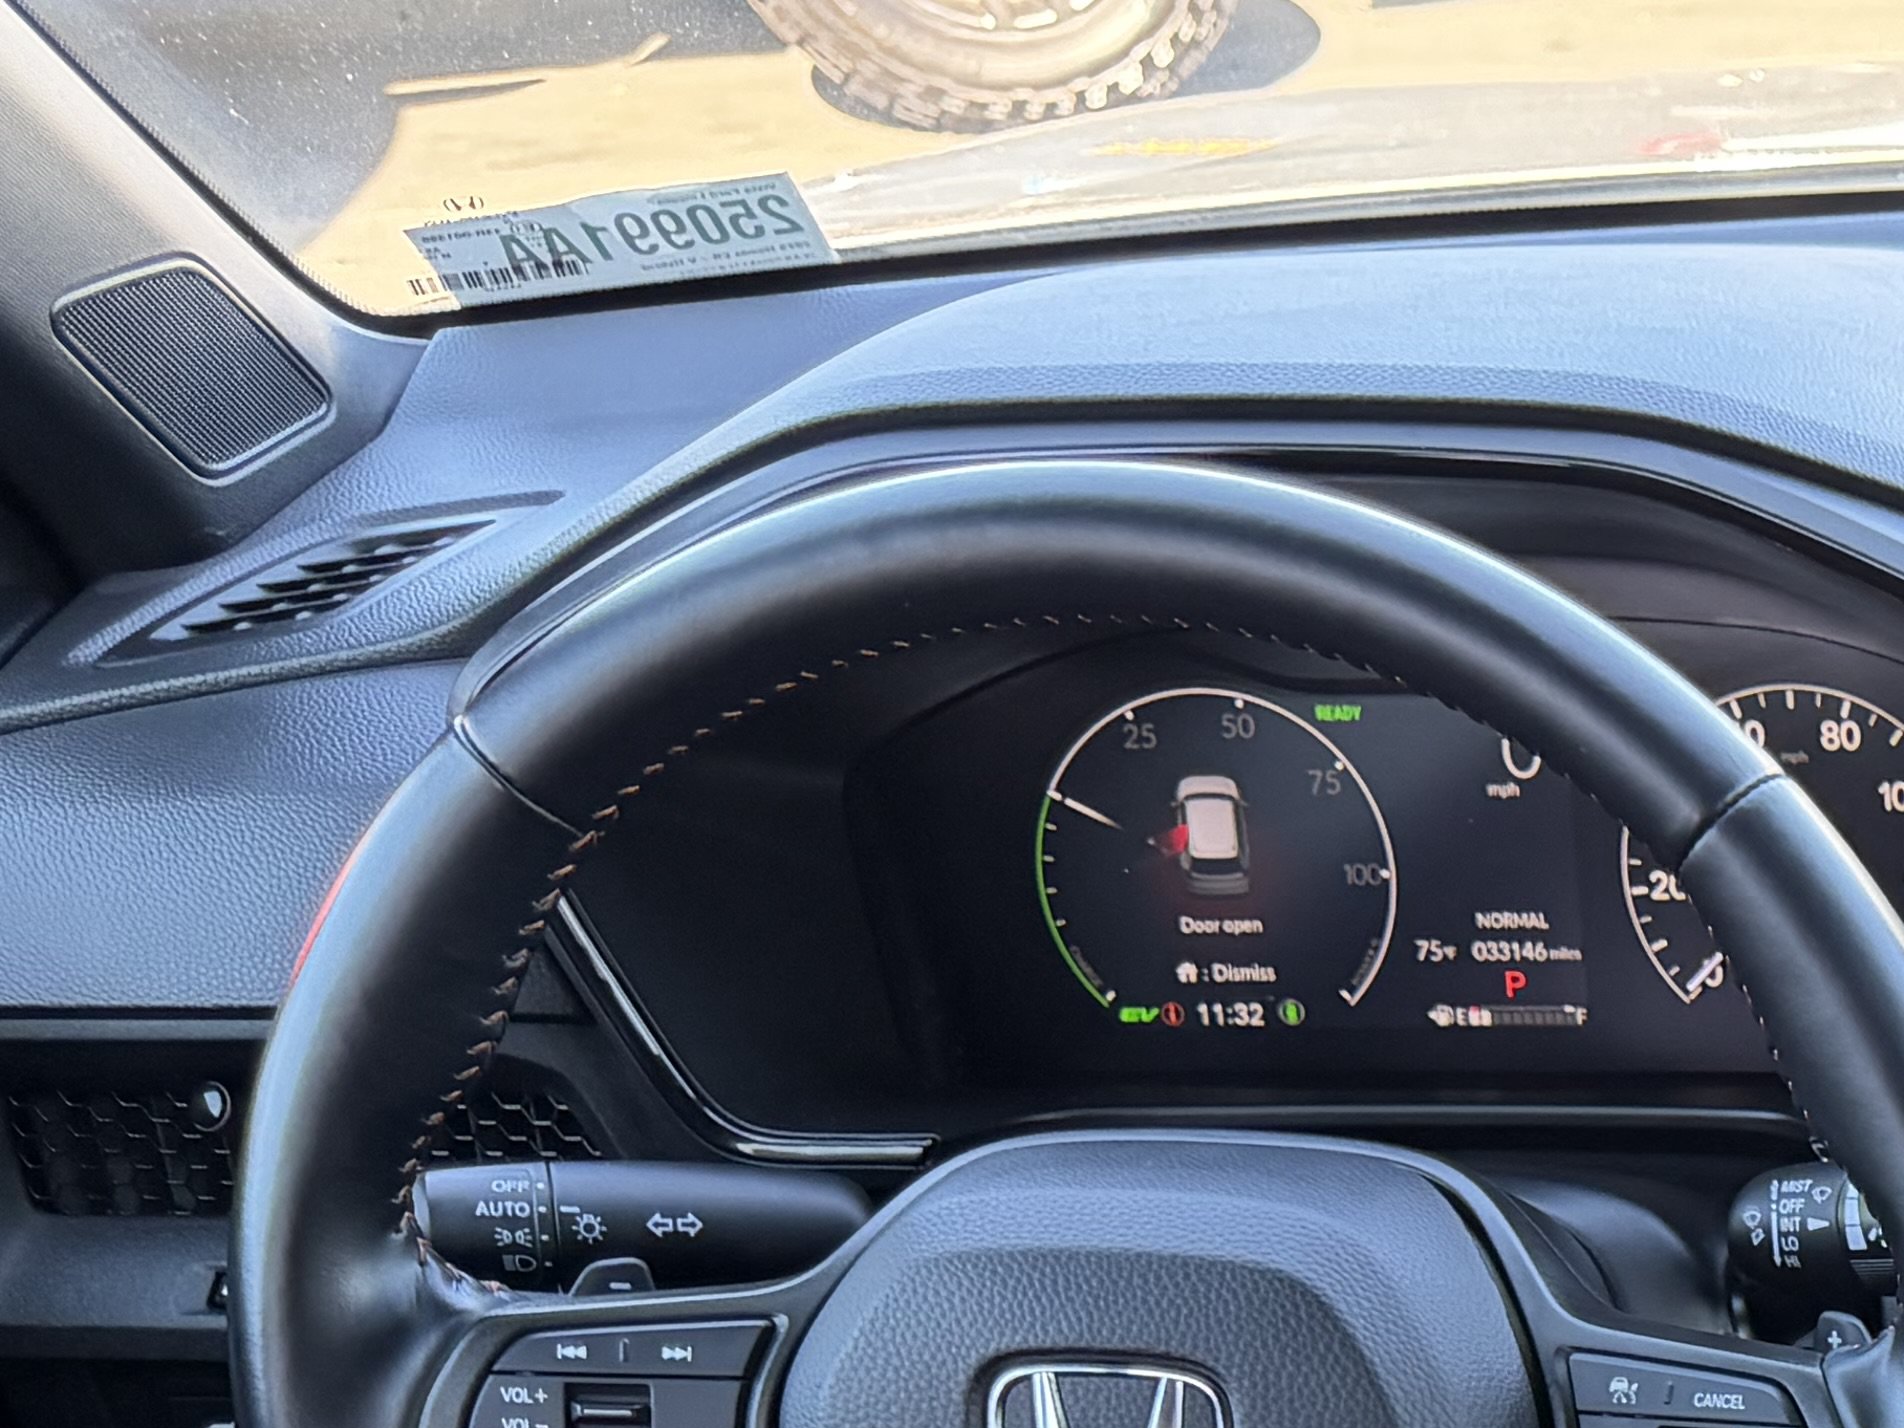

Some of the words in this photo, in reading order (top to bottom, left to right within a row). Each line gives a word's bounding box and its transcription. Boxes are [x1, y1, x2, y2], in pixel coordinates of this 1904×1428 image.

[1314, 703, 1362, 724] READY
[1122, 723, 1157, 750] 25
[1221, 713, 1256, 741] 50
[1819, 719, 1863, 752] 80
[1307, 769, 1342, 797] 75
[1485, 781, 1520, 800] mph
[1344, 863, 1382, 887] 100
[1179, 915, 1219, 934] Door
[1222, 918, 1264, 936] open
[1474, 911, 1549, 930] NORMAL
[1471, 940, 1548, 963] 033146
[1211, 963, 1277, 983] Dismiss
[1504, 969, 1527, 998] P
[1118, 1006, 1160, 1023] EV
[1197, 1001, 1265, 1027] 11:32
[1456, 1007, 1467, 1027] E
[1576, 1008, 1588, 1026] F
[490, 1178, 530, 1193] OFF
[1780, 1179, 1813, 1193] MIST
[475, 1200, 531, 1218] AUTO
[1779, 1197, 1806, 1214] OFF
[1780, 1216, 1801, 1232] INT
[1781, 1236, 1800, 1252] LO
[1693, 1392, 1746, 1410] CANCEL
